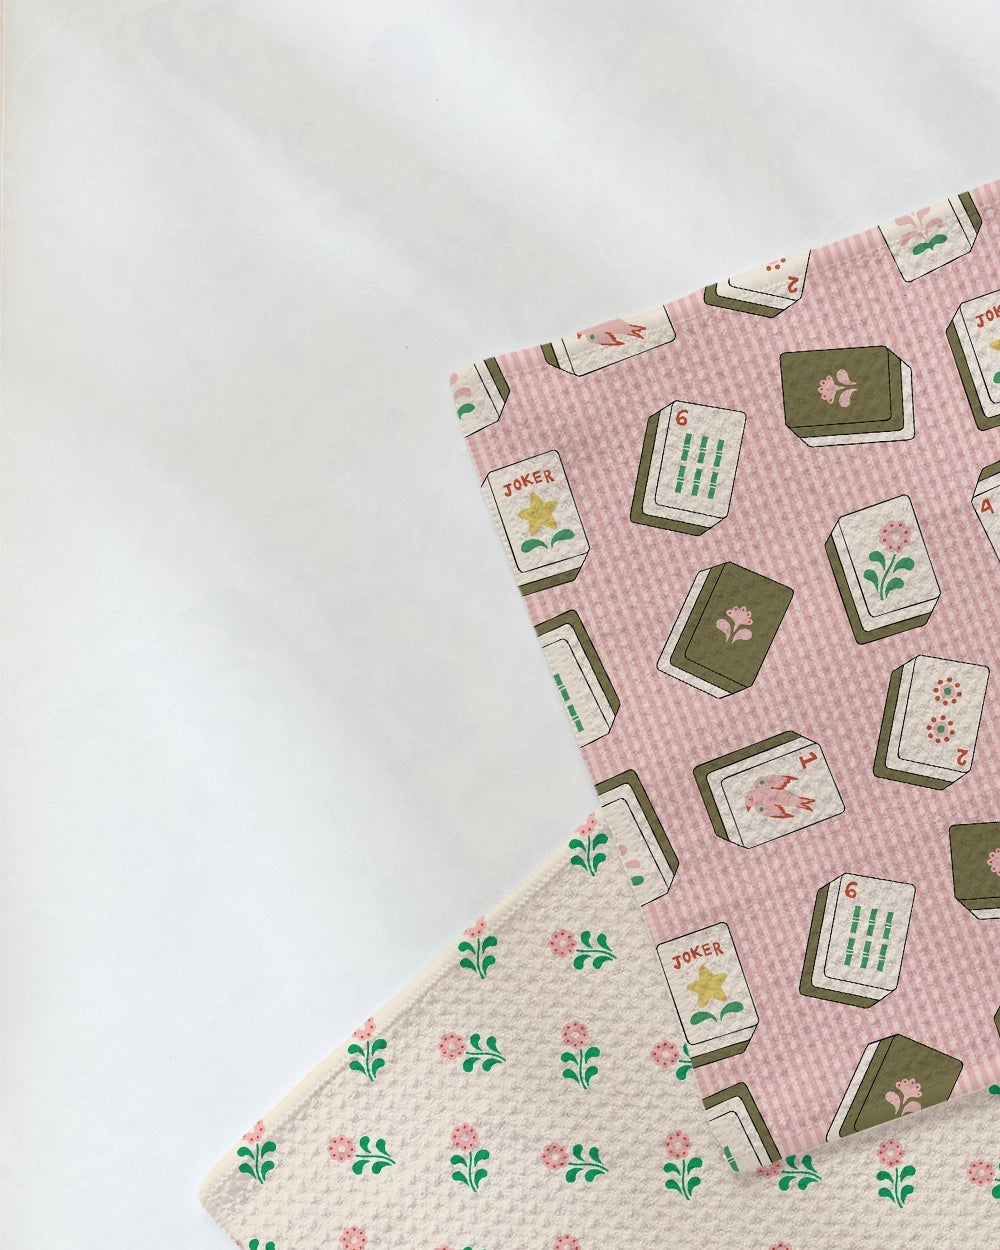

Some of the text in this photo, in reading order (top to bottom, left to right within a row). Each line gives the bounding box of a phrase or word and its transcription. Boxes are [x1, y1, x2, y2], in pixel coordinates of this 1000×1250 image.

[787, 275, 800, 294] 2
[675, 408, 689, 427] 6
[502, 469, 554, 497] JOKER
[980, 498, 995, 514] 4
[799, 751, 818, 769] 1
[956, 748, 969, 767] 2
[844, 881, 858, 899] 6
[672, 941, 724, 970] JOKER
